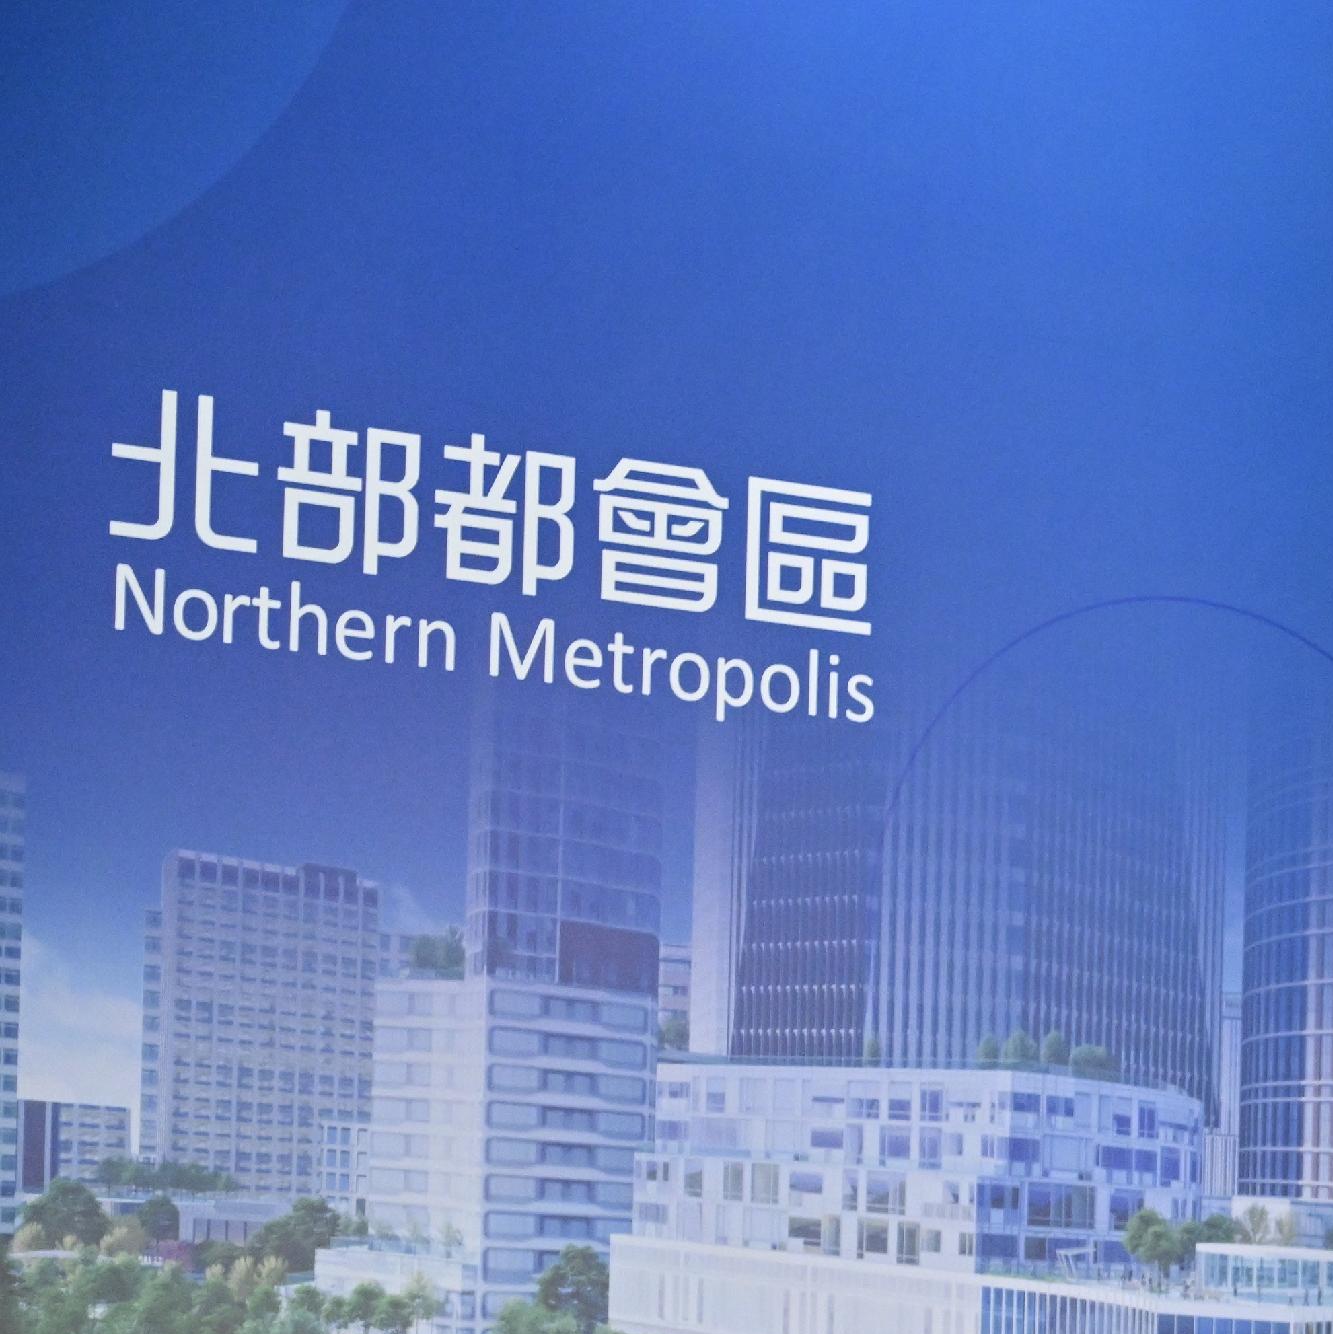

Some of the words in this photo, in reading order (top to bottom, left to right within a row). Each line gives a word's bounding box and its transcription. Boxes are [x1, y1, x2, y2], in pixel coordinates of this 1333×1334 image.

[108, 388, 873, 636] 北部都會區
[113, 563, 457, 673] Northern
[488, 611, 876, 724] Metropolis
